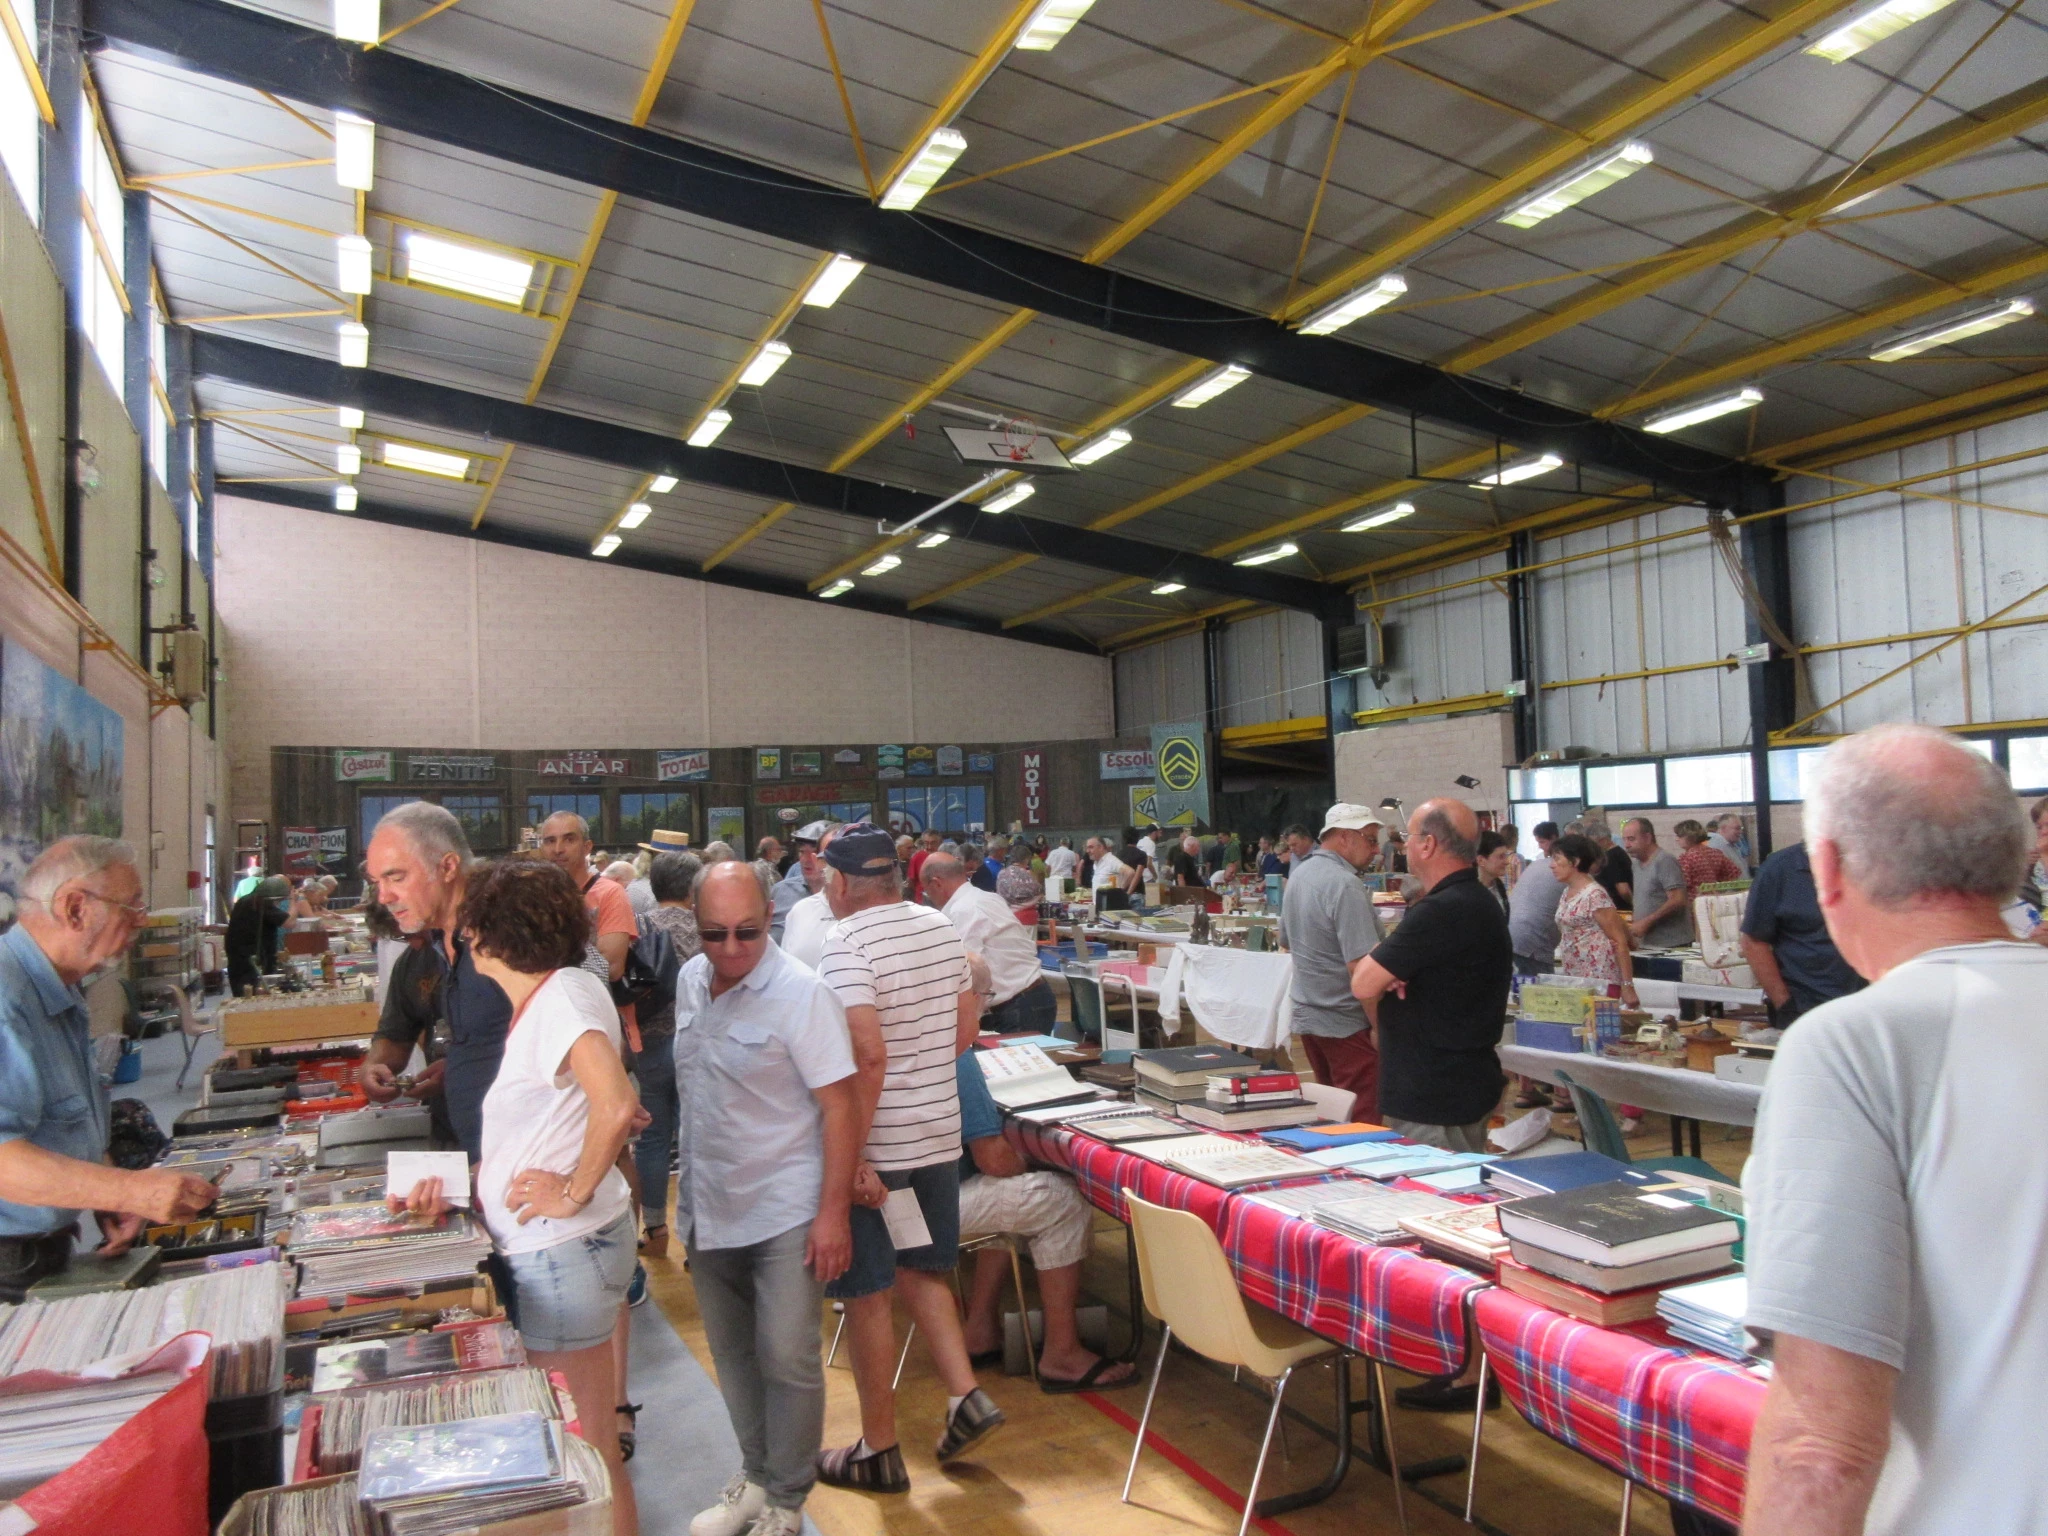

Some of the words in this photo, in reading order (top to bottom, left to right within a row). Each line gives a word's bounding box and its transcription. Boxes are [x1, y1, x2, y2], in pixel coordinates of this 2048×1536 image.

[543, 760, 625, 774] ANTAR
[661, 755, 708, 777] TOTAL
[761, 756, 777, 767] BP
[412, 764, 493, 779] ZENITH
[1024, 754, 1040, 824] MOTUL
